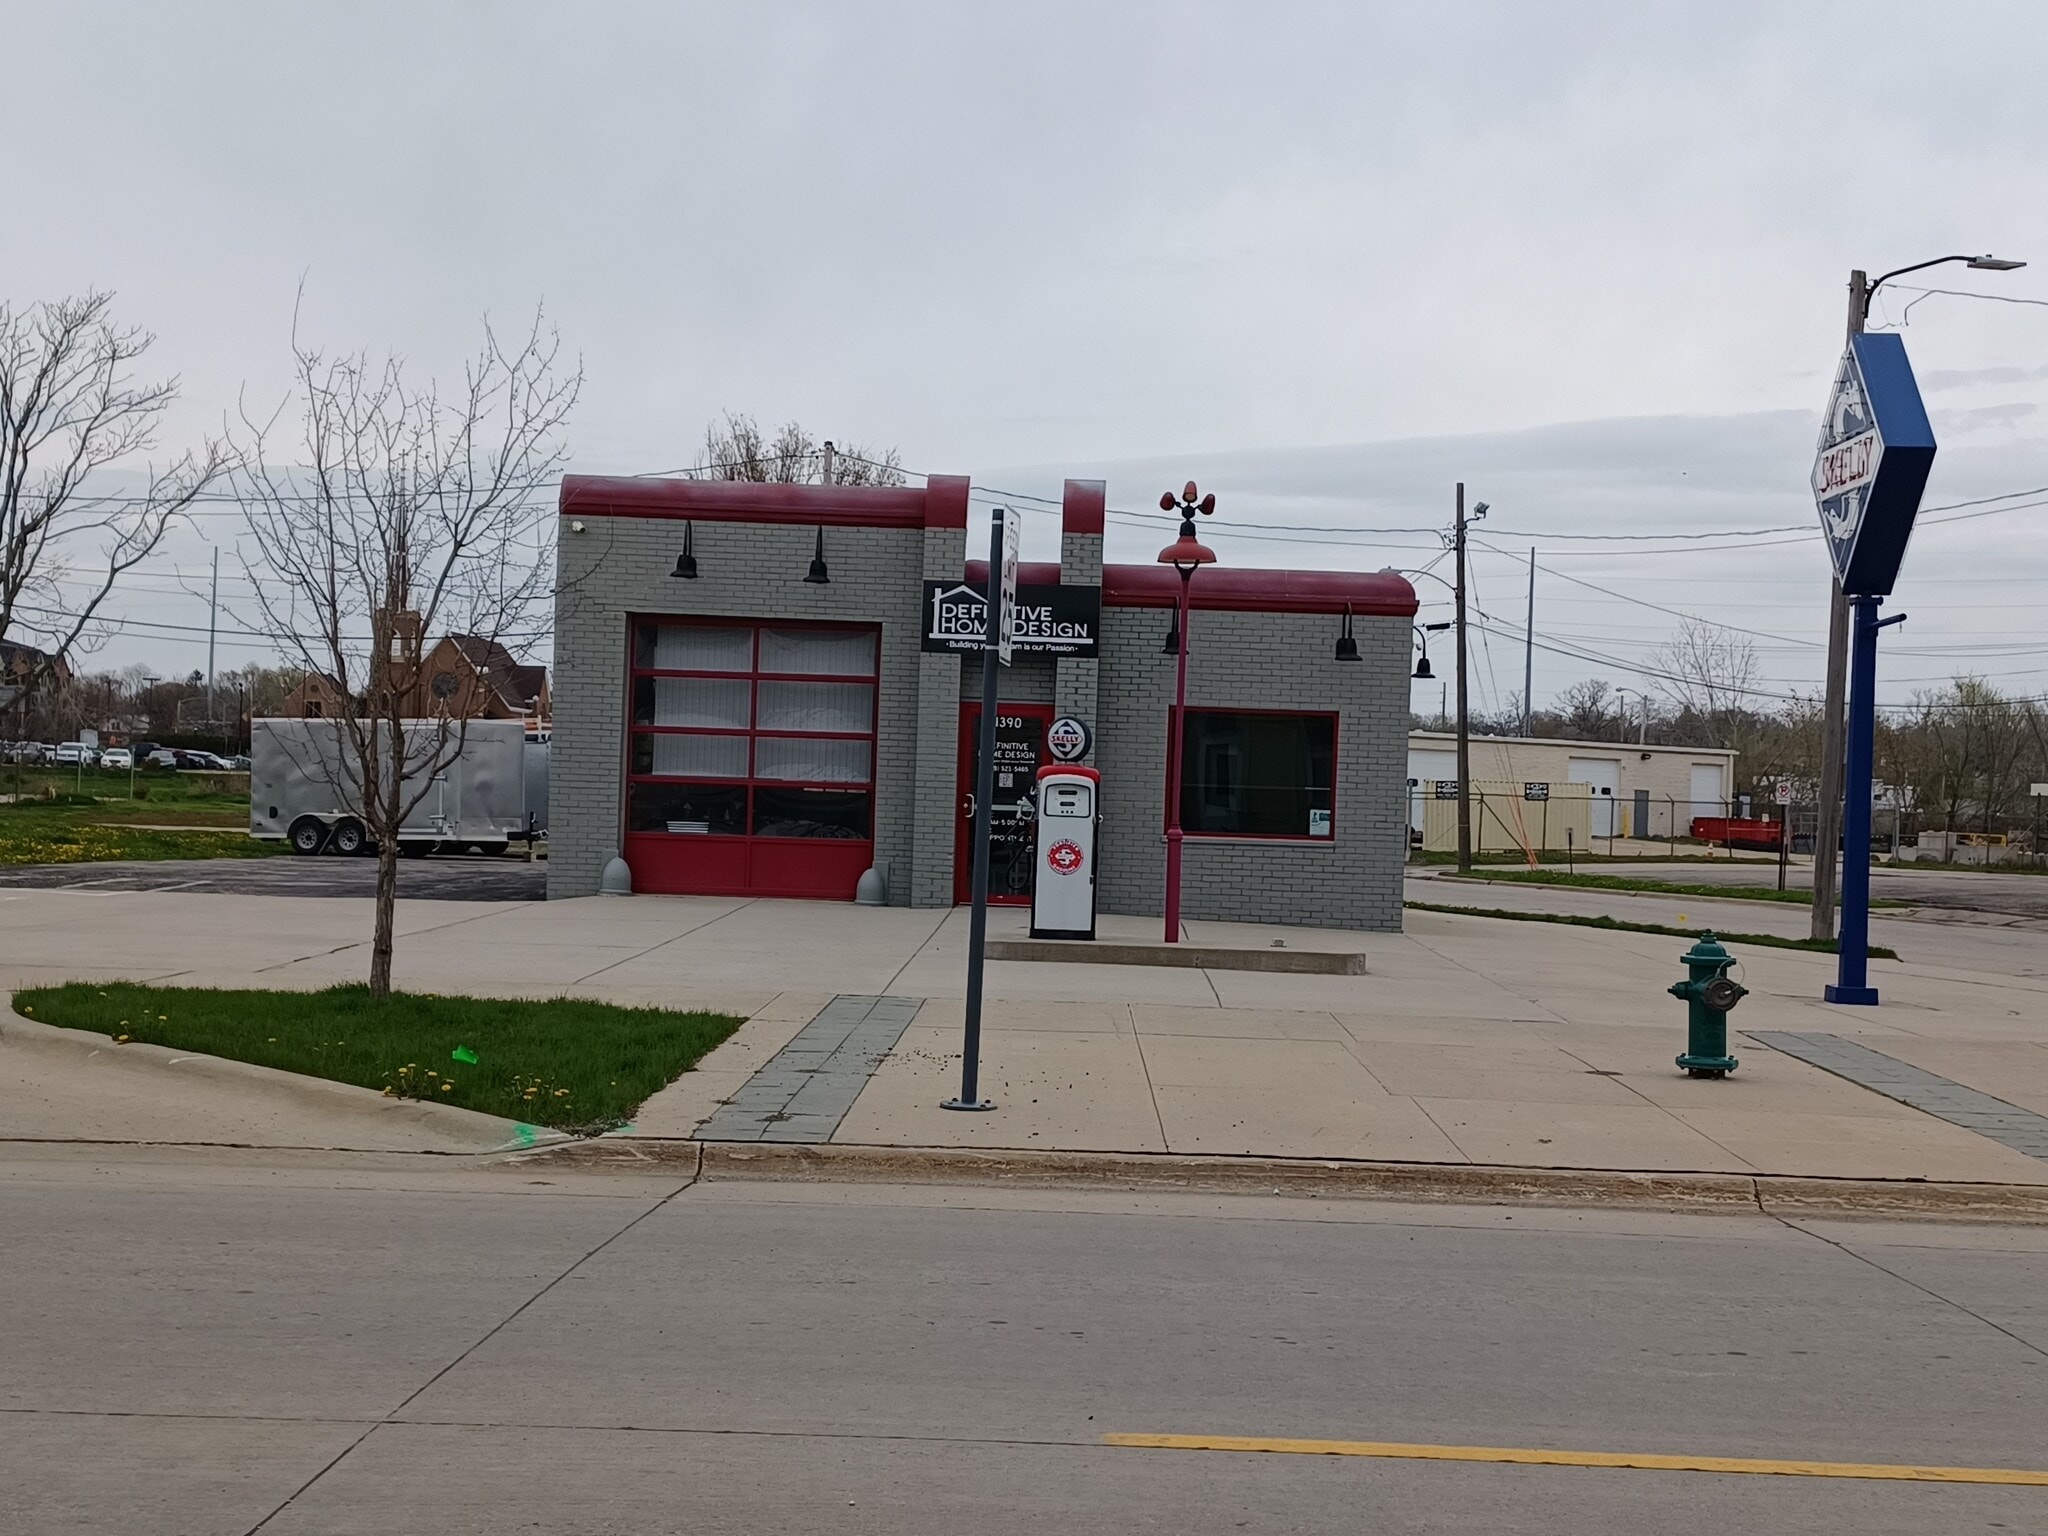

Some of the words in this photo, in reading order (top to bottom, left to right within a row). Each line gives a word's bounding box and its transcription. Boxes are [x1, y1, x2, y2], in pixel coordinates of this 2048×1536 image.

[941, 603, 1052, 621] DEFITIVE
[941, 617, 987, 634] HOM
[1011, 620, 1088, 638] DESIGN
[995, 716, 1022, 729] 1390
[1051, 735, 1079, 743] SKELLY
[996, 742, 1029, 751] FINITIVE
[1004, 751, 1036, 759] DESIGN
